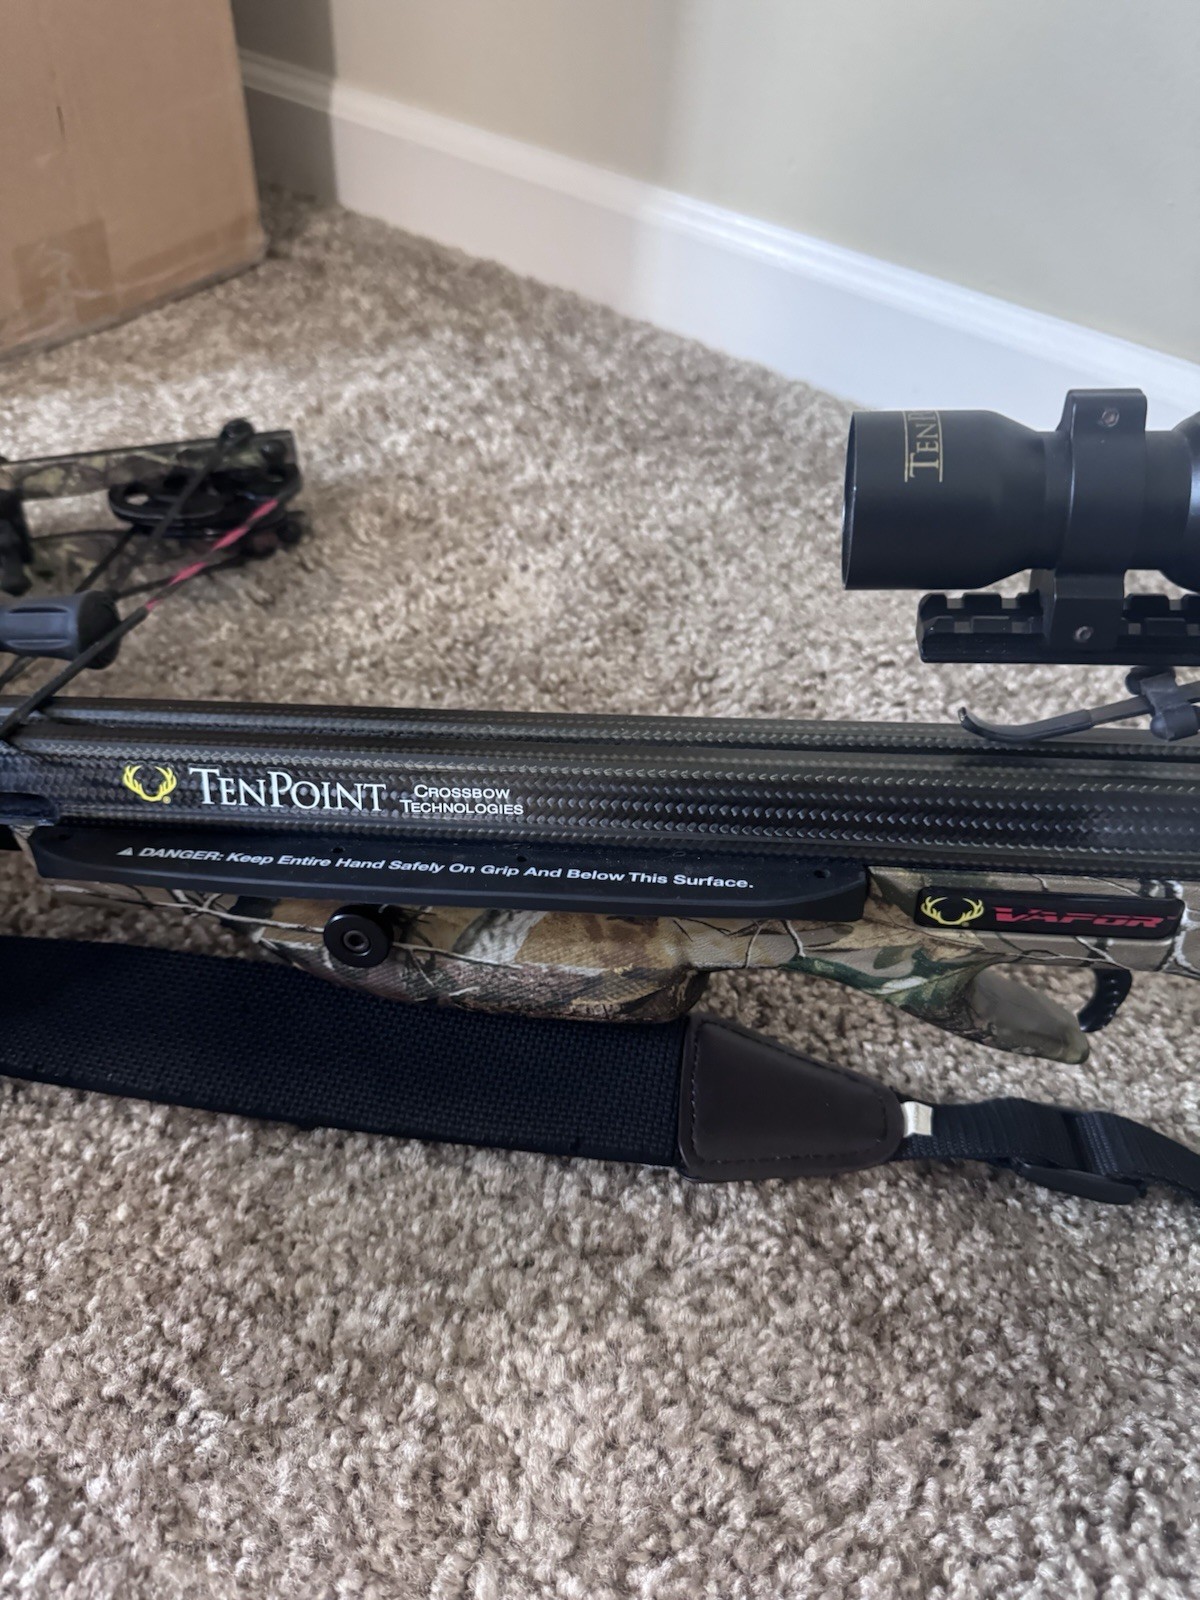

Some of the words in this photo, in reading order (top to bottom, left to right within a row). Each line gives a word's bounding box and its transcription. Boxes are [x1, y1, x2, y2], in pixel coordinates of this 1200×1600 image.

[138, 847, 224, 862] DANGER:
[226, 852, 274, 866] Keep
[276, 855, 332, 868] Entire
[335, 857, 386, 870] Hand
[388, 860, 445, 874] Safely
[449, 863, 475, 874] On
[480, 864, 520, 877] Grip
[523, 867, 562, 878] And
[566, 869, 625, 882] Below
[628, 872, 668, 884] This
[673, 874, 754, 889] Surface.
